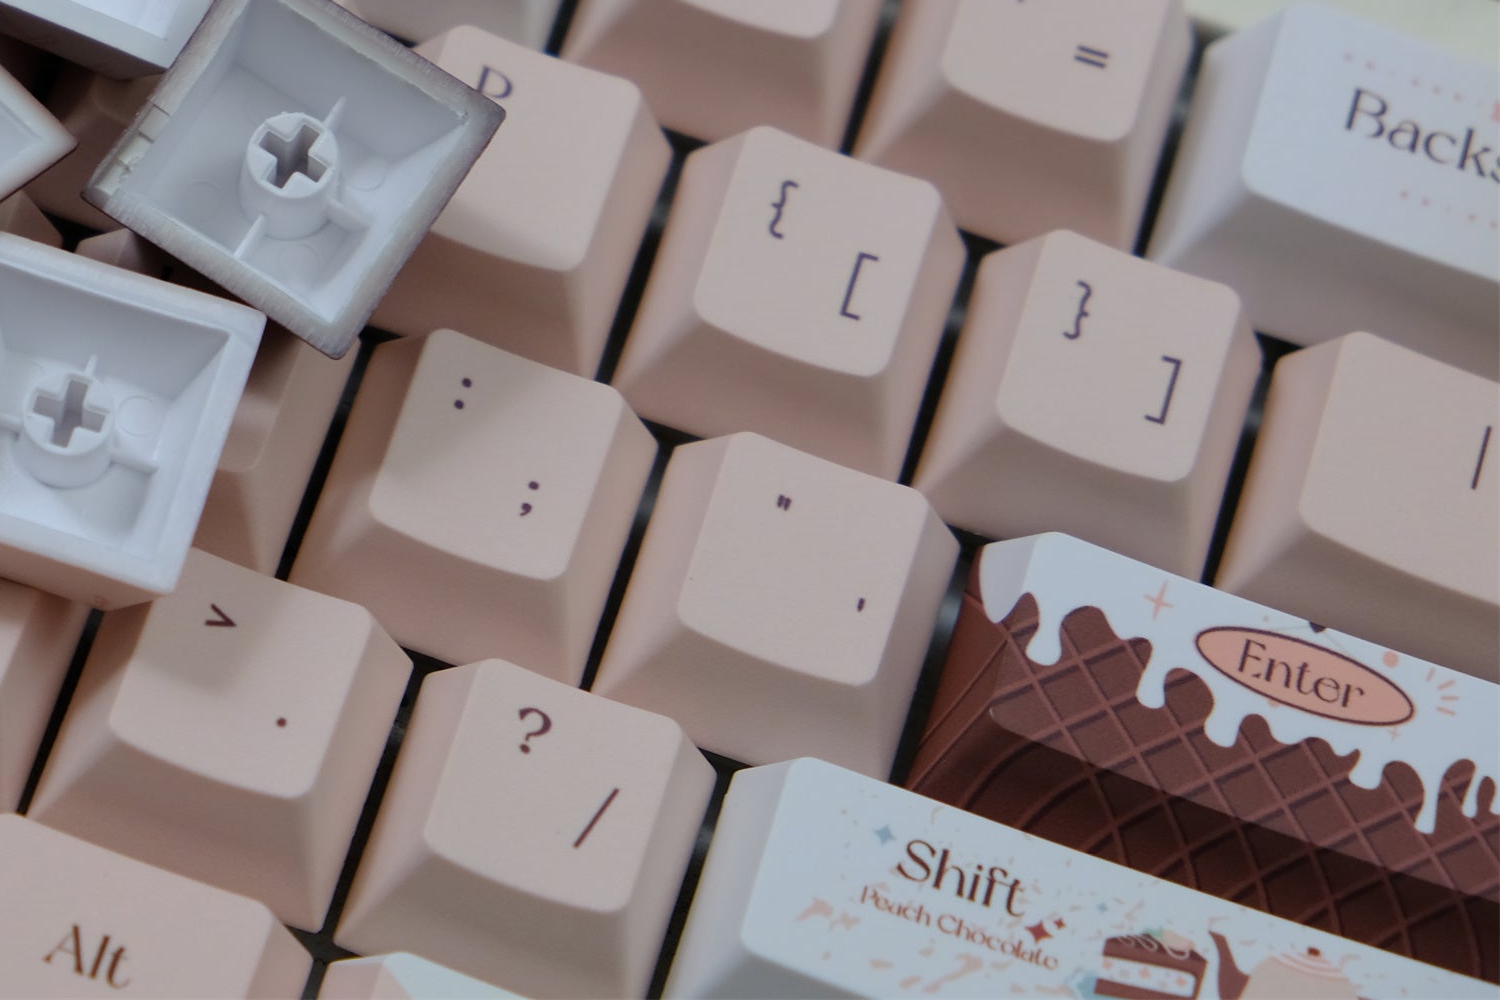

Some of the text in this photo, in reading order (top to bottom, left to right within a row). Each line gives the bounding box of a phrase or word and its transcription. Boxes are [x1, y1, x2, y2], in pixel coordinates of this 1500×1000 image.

[1074, 46, 1109, 69] =
[769, 180, 798, 239] {
[840, 252, 878, 320] [
[1063, 281, 1092, 340] }
[454, 378, 472, 409] :
[1145, 356, 1182, 425] ]
[520, 481, 539, 516] ;
[205, 604, 236, 627] >
[1237, 638, 1366, 710] Enter
[519, 708, 551, 754] ?
[573, 788, 619, 848] /
[896, 839, 1025, 918] Shift
[43, 924, 132, 989] Alt
[861, 886, 1060, 970] Peach Chocolate
